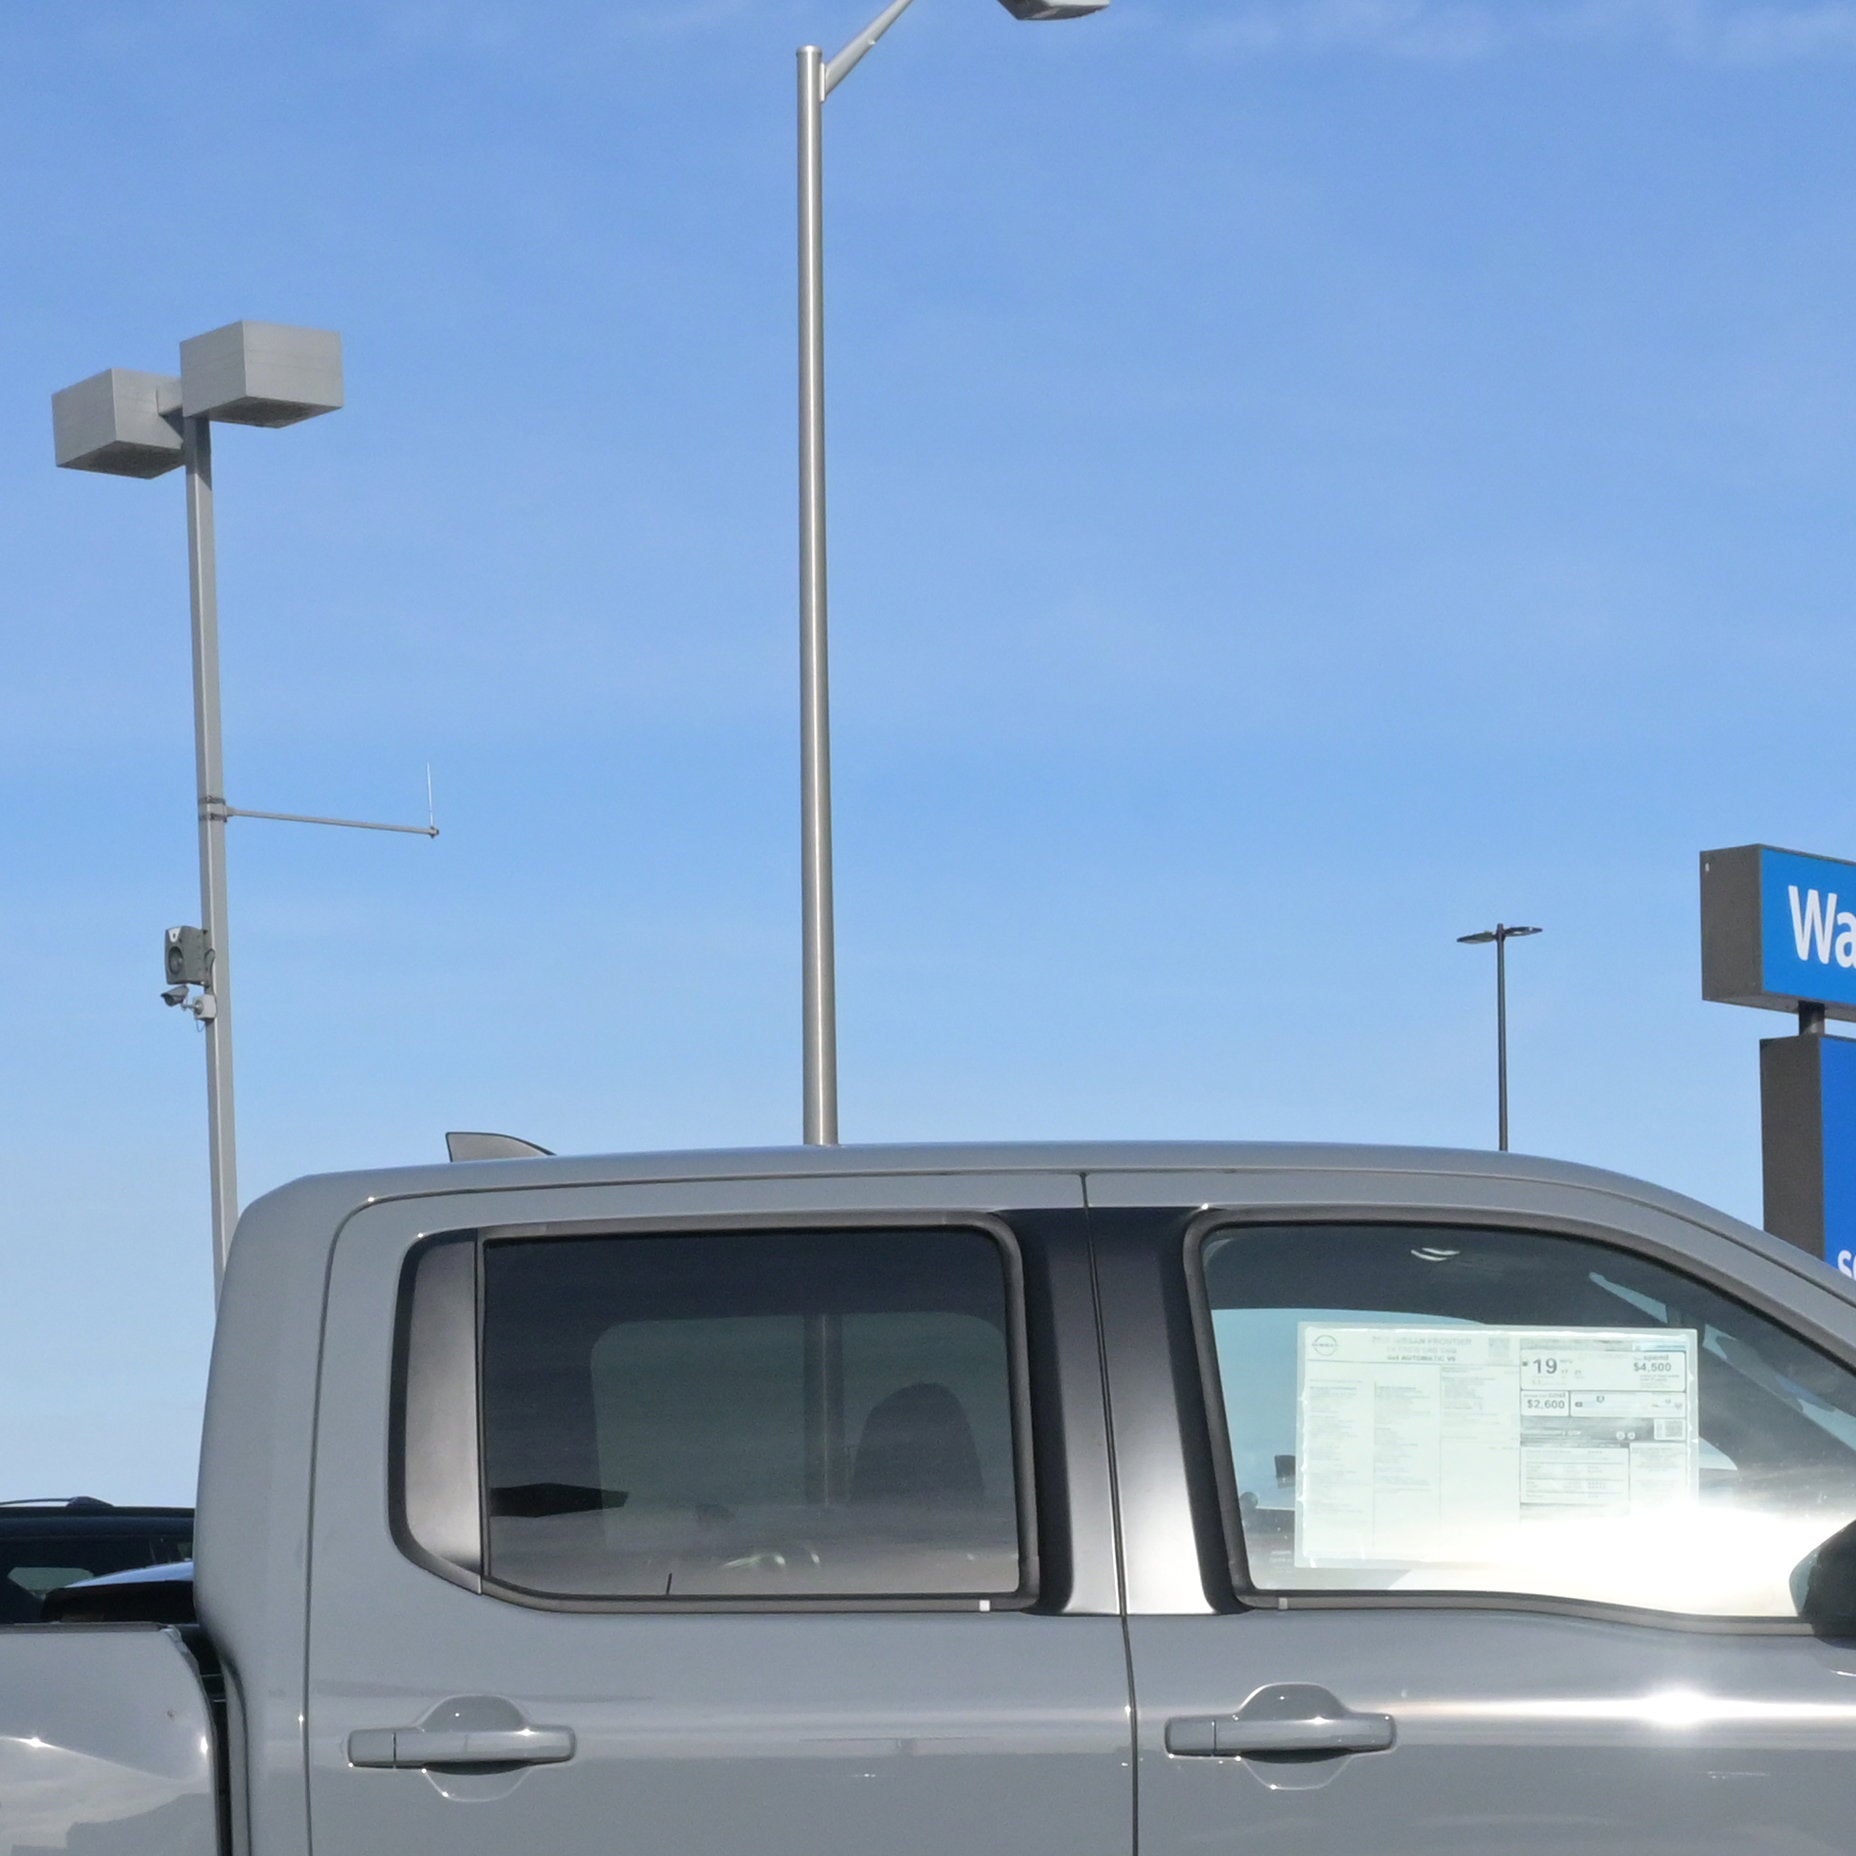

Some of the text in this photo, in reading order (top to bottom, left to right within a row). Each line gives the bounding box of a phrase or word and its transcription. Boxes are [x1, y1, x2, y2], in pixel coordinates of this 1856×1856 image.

[1533, 1357, 1557, 1374] 19
[1633, 1362, 1672, 1373] $4,500
[1527, 1399, 1565, 1409] $2,600
